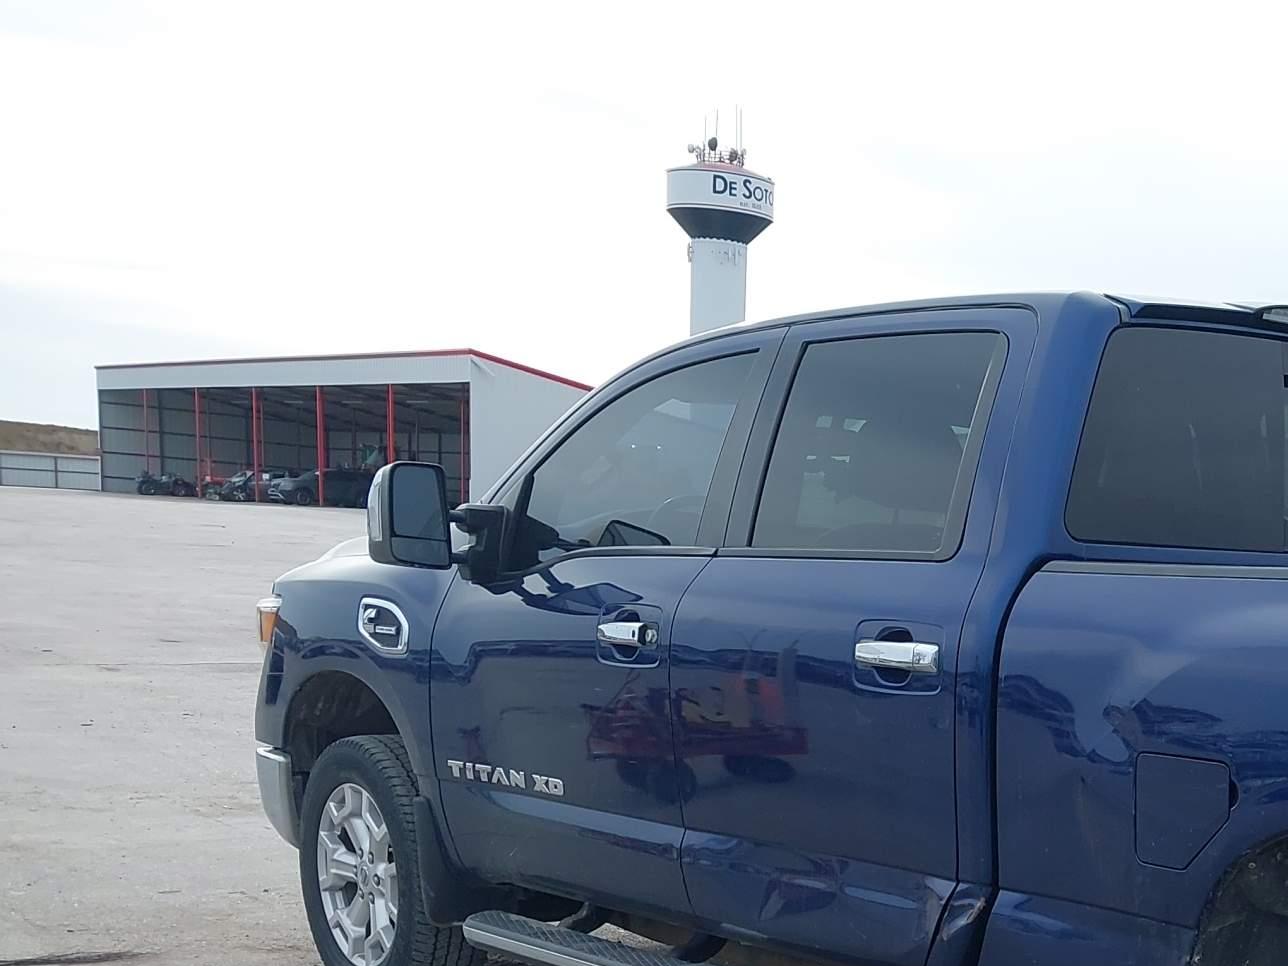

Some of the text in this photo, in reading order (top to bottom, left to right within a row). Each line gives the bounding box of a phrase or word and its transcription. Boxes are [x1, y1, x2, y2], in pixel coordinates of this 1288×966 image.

[712, 174, 738, 197] DE
[447, 759, 565, 796] TITAN XD
